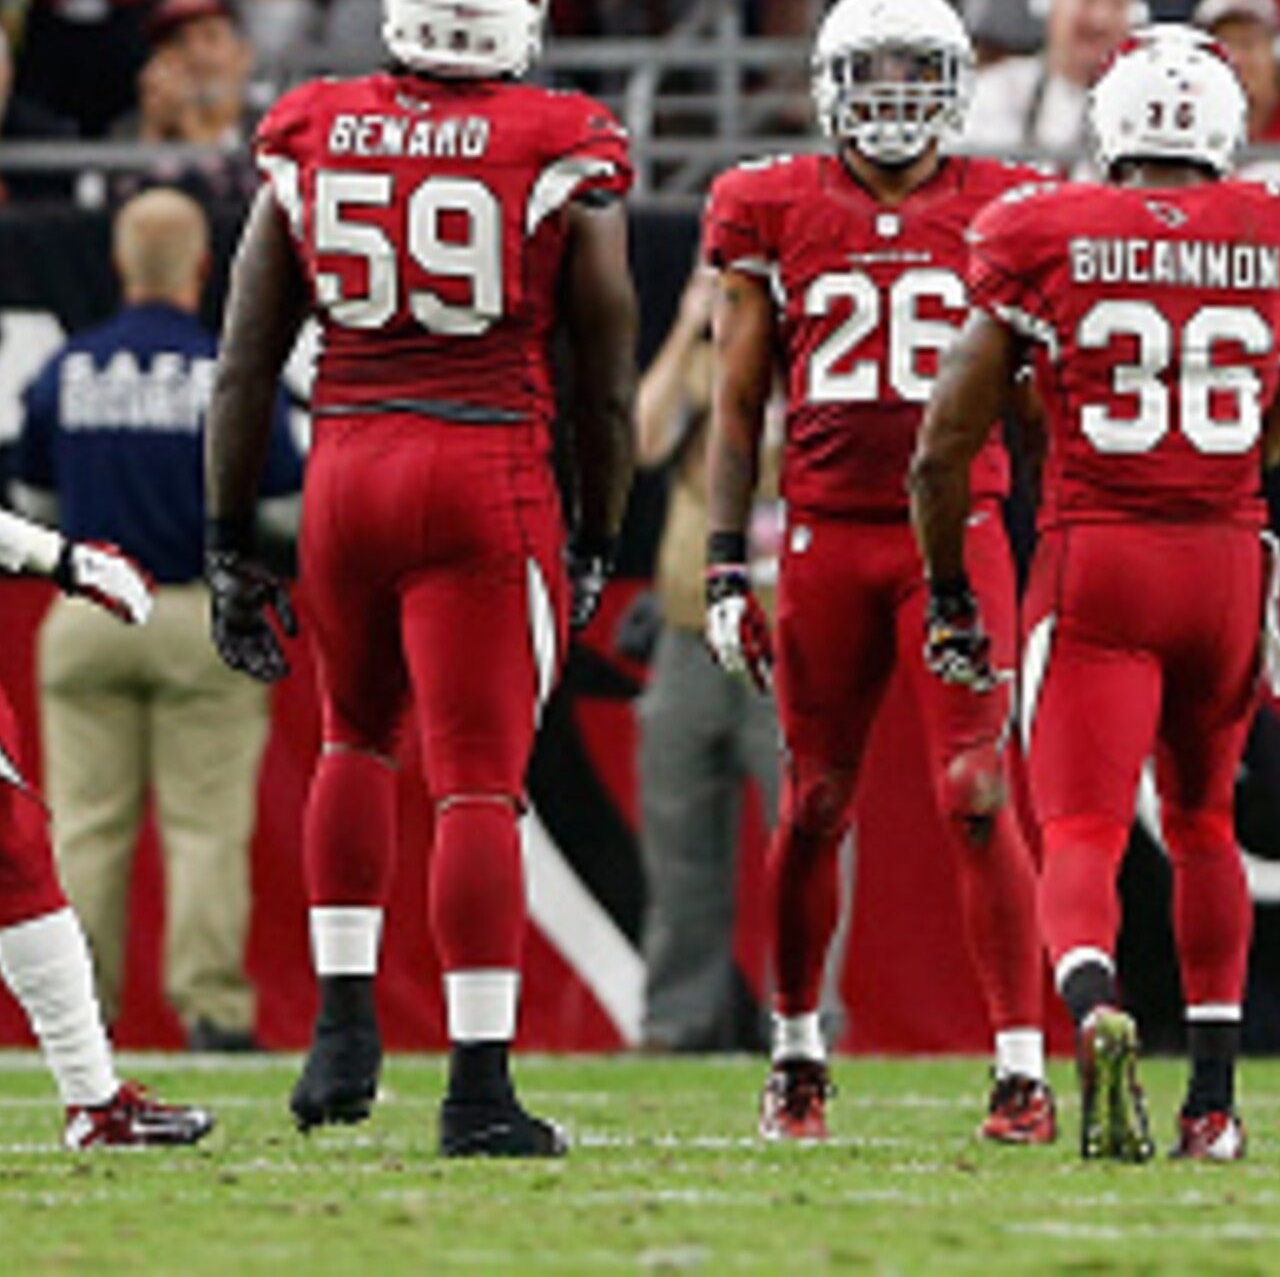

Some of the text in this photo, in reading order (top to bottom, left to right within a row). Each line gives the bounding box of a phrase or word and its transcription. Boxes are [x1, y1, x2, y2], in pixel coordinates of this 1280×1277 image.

[314, 170, 504, 336] 59
[803, 268, 968, 404] 26
[1077, 299, 1273, 455] 36
